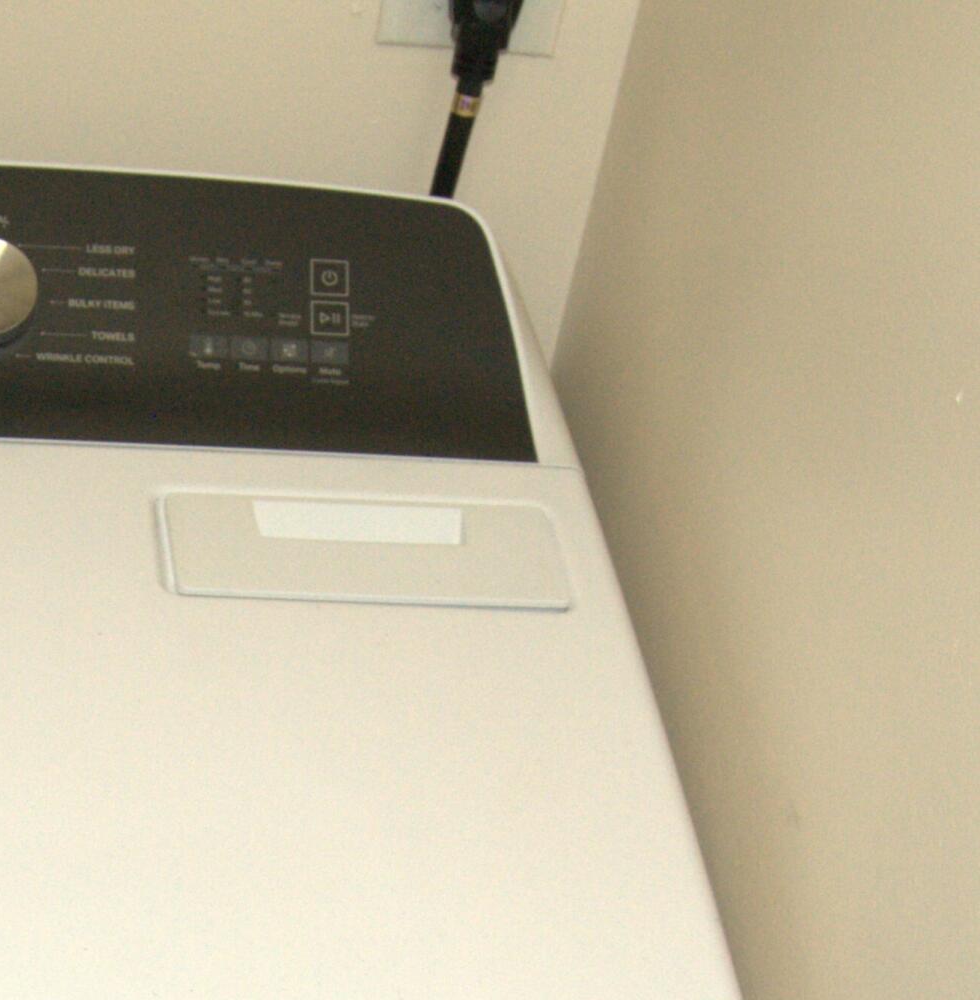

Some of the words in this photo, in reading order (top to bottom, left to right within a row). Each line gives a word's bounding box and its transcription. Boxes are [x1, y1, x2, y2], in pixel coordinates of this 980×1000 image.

[115, 245, 135, 255] DRY
[77, 267, 136, 278] DELICATES
[68, 298, 101, 308] BULKY
[103, 300, 135, 310] ITEMS
[91, 330, 136, 342] TOWELS
[35, 352, 83, 363] WRINKLE
[84, 354, 135, 366] CONTROL
